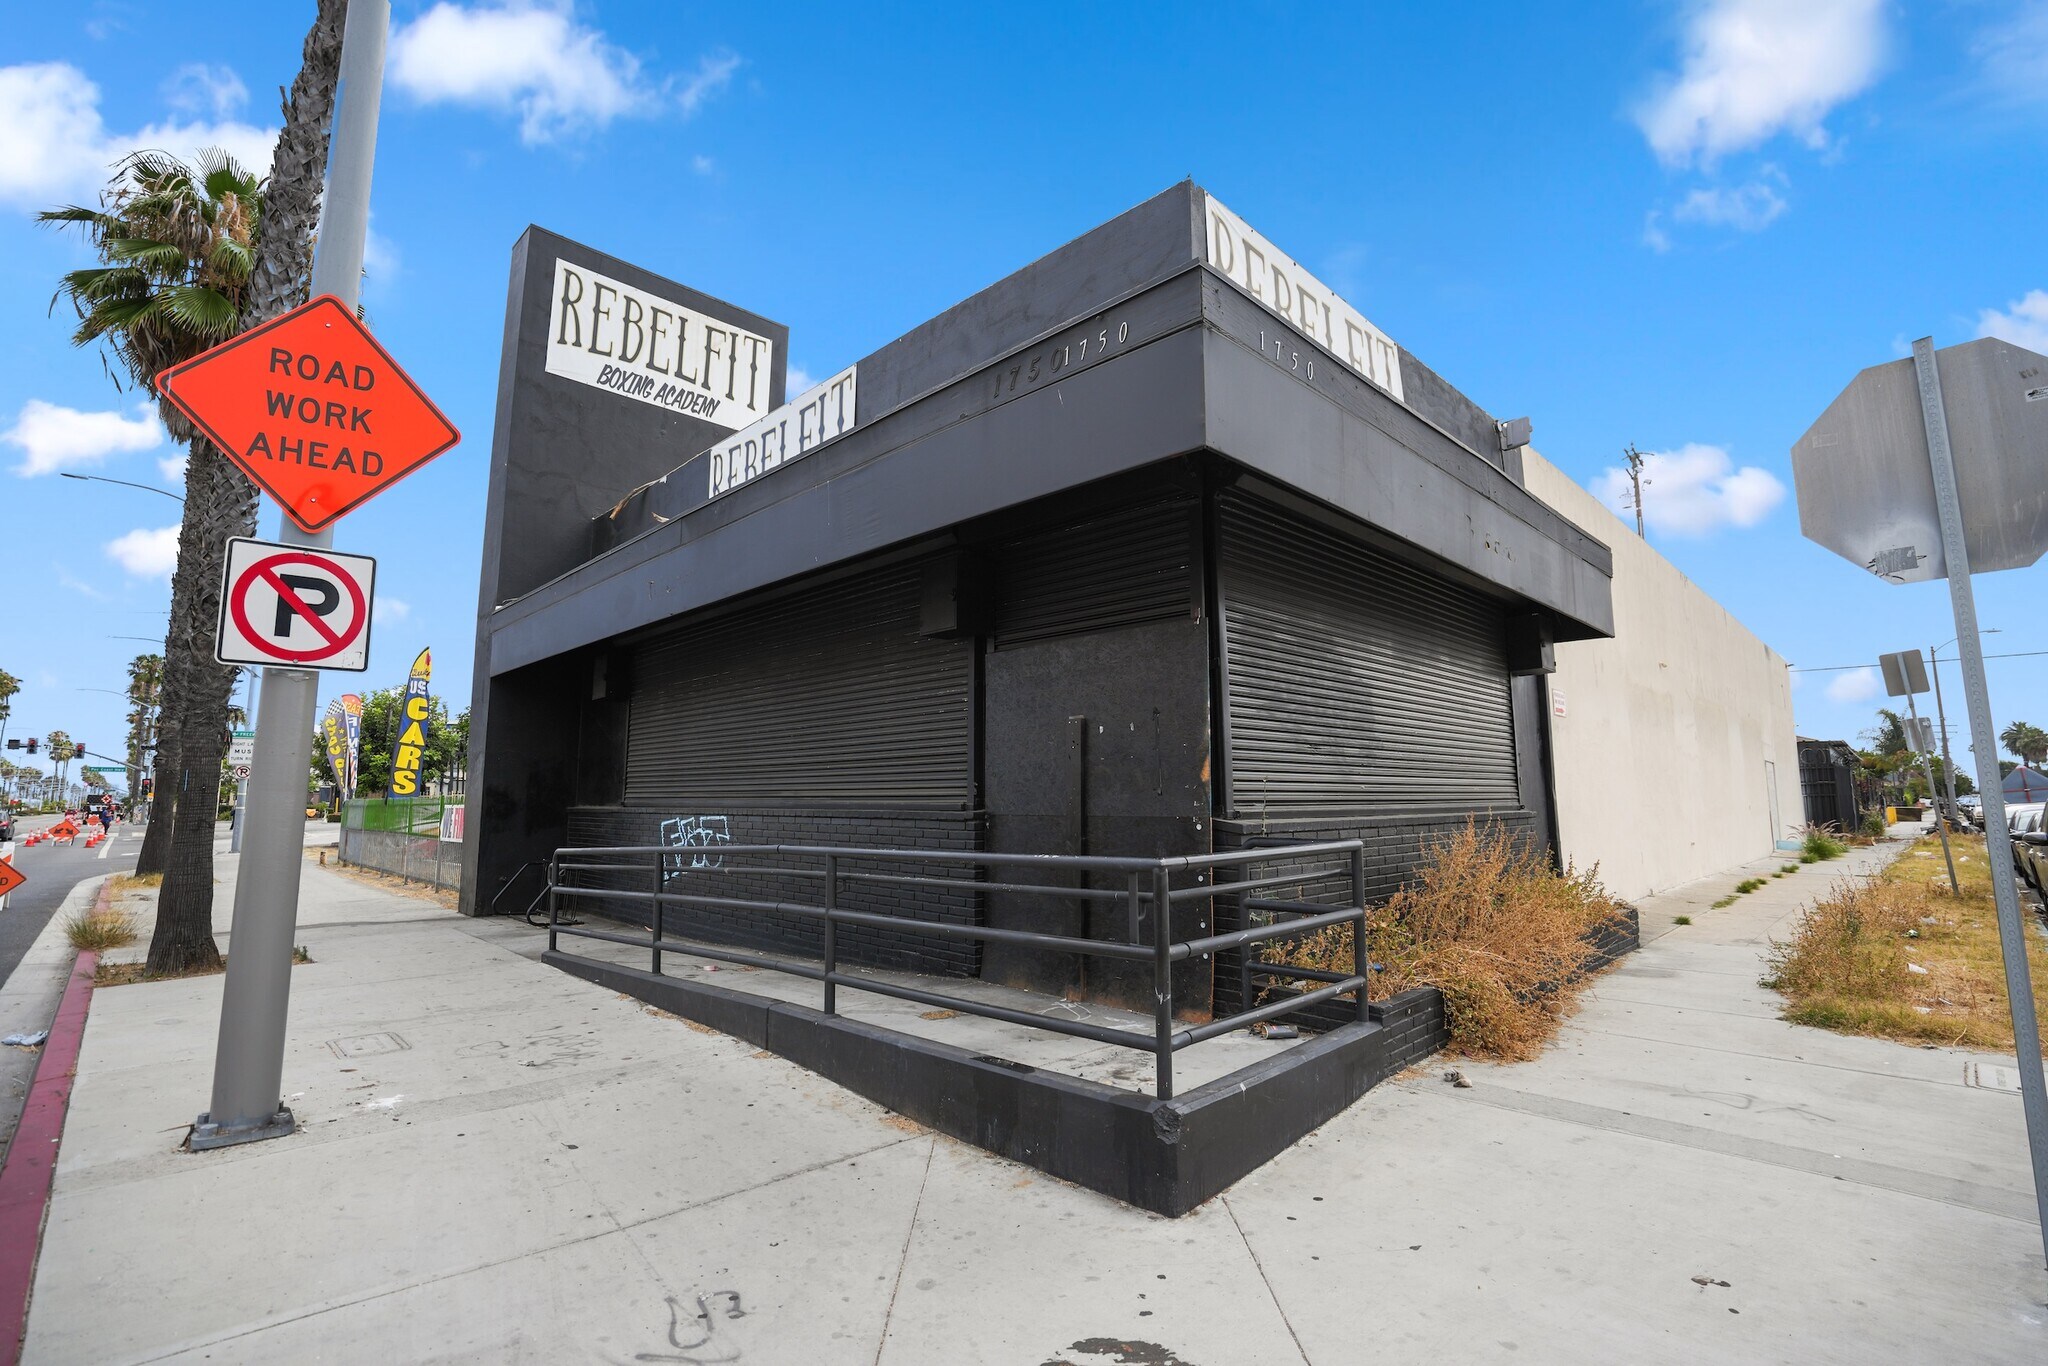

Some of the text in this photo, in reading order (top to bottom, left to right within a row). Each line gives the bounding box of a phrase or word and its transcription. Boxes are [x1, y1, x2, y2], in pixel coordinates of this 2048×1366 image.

[556, 267, 767, 411] REBELFIT
[1064, 321, 1129, 366] 1750
[1260, 330, 1314, 380] 1750
[269, 347, 375, 392] ROAD
[596, 363, 721, 418] BOXING ACADEMY
[993, 346, 1066, 399] 1750
[265, 389, 373, 435] WORK
[245, 431, 384, 478] AHEAD
[392, 696, 429, 795] CARS
